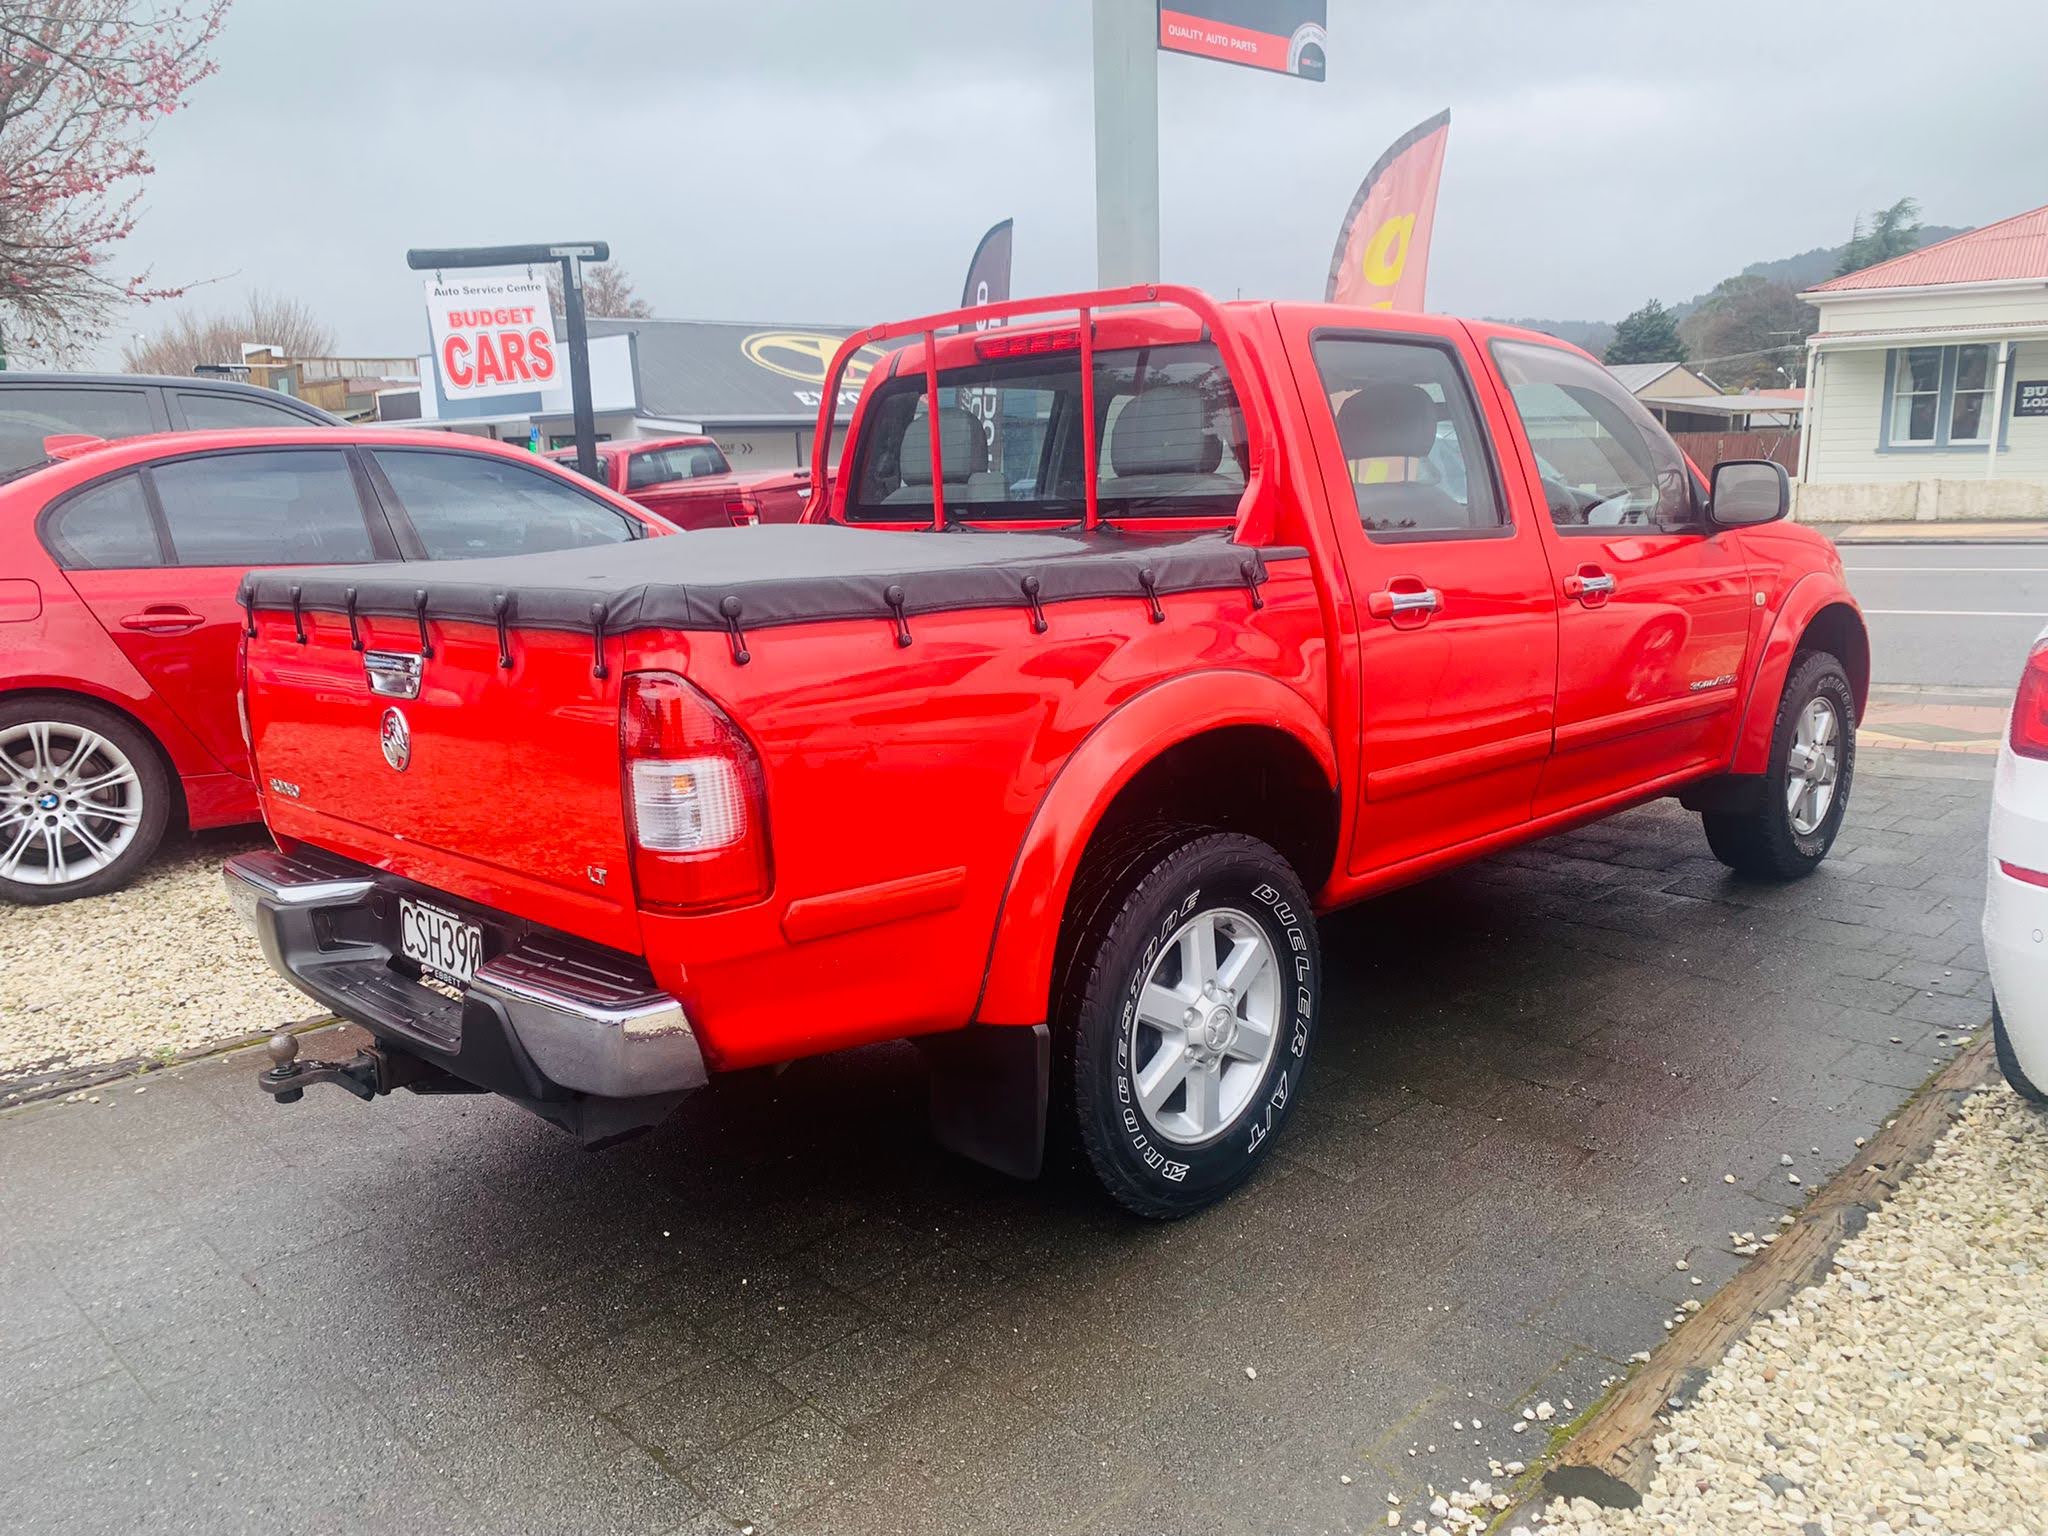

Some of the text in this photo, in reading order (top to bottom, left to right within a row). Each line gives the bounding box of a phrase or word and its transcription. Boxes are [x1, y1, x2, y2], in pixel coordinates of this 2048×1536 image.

[1168, 24, 1257, 53] QUALITY AUTO PARTS
[434, 283, 542, 297] Auto Service Centre
[447, 307, 536, 329] BUDGET
[443, 327, 556, 390] CARS
[587, 865, 607, 886] LT
[1251, 883, 1311, 1058] DUELER
[1116, 889, 1200, 1182] BRIDGESTONE
[1248, 1070, 1289, 1153] A/T
